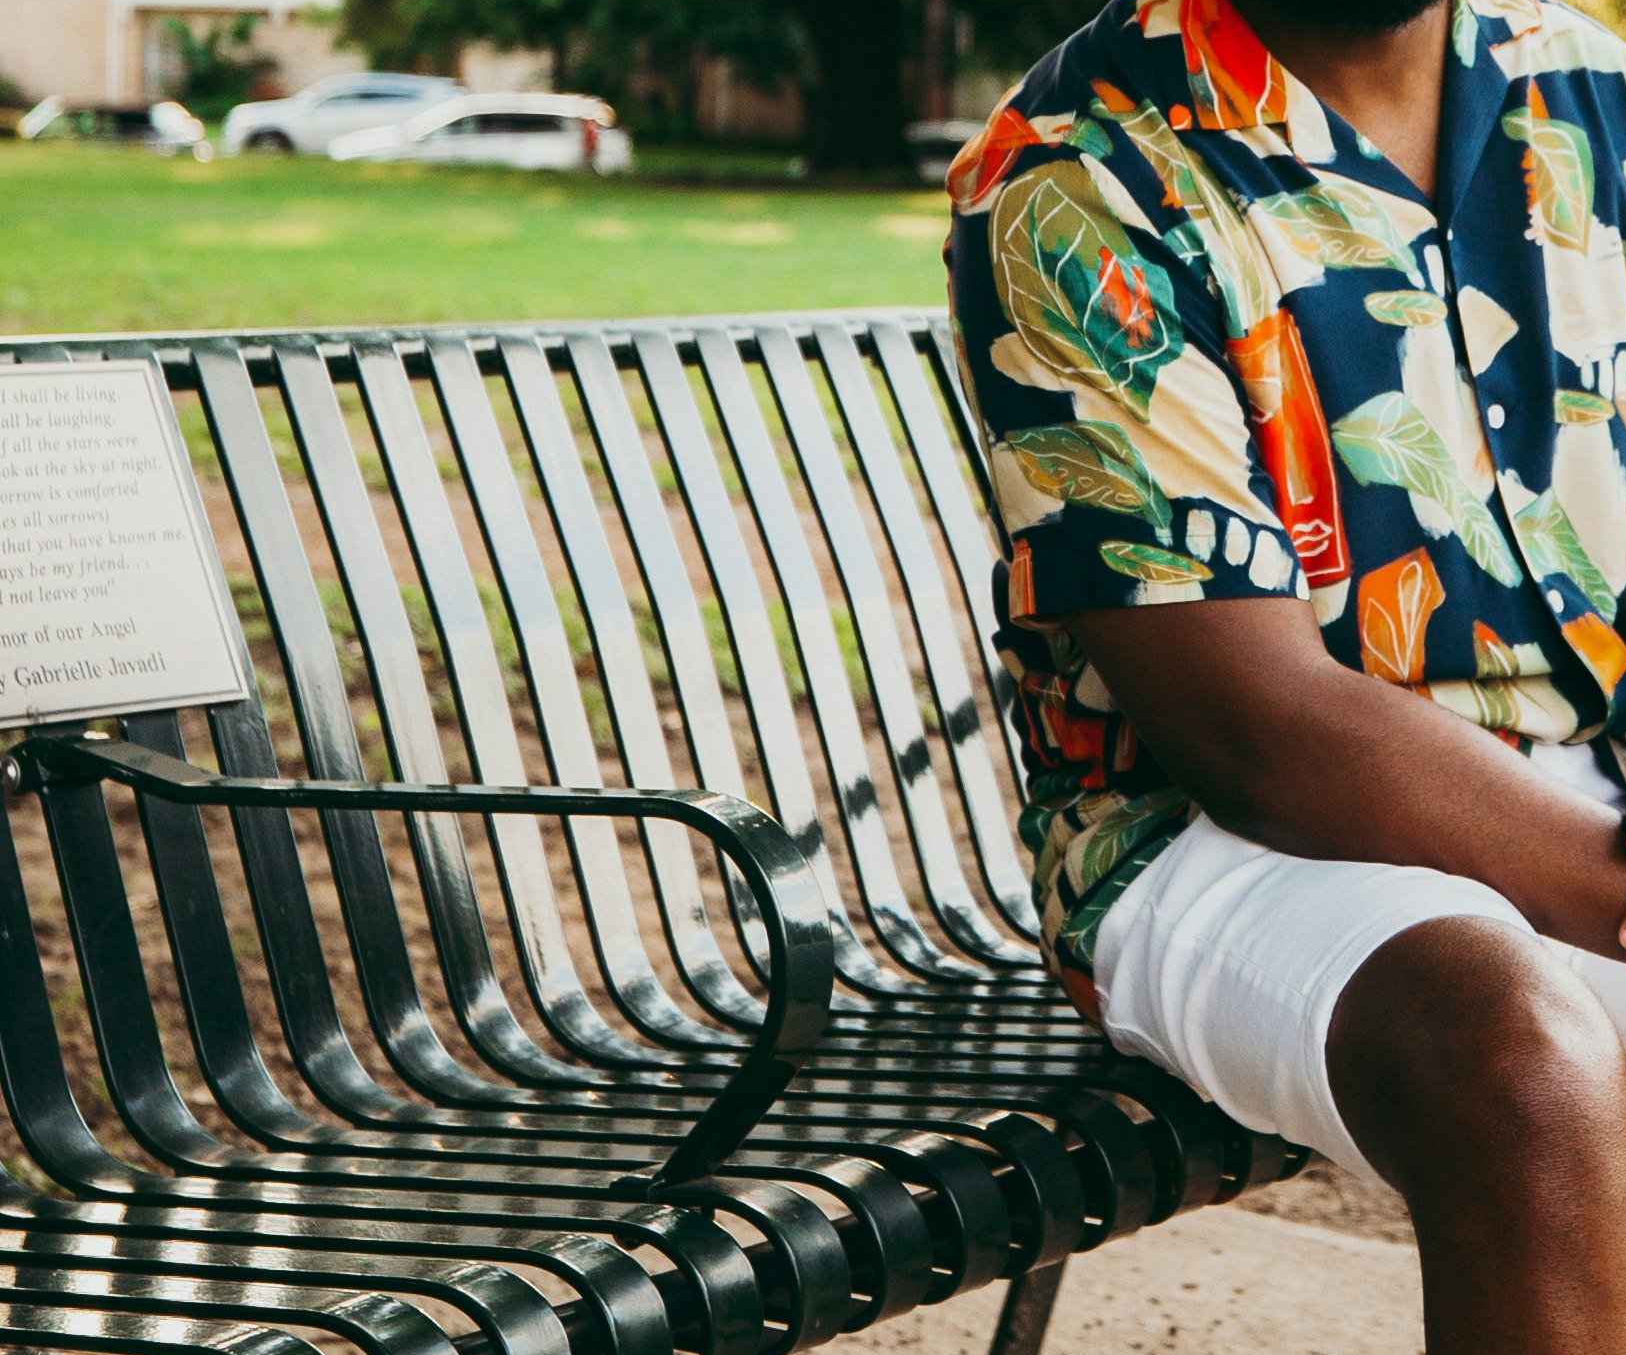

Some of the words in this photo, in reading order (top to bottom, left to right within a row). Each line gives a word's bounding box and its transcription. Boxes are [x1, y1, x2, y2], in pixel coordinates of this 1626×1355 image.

[13, 388, 48, 404] shall
[54, 387, 69, 402] be
[76, 386, 120, 404] living.
[25, 412, 42, 428] be
[48, 409, 116, 429] laughing.
[13, 436, 32, 453] all
[38, 435, 60, 452] the
[66, 435, 101, 450] stars
[105, 435, 138, 448] were
[25, 463, 39, 477] at
[45, 459, 66, 476] the
[73, 458, 96, 479] sky
[102, 458, 117, 473] at
[121, 453, 162, 475] night.
[49, 484, 61, 501] is
[67, 479, 139, 502] comforted
[23, 510, 42, 528] all
[47, 507, 110, 526] sorrows)
[1, 536, 33, 555] that
[36, 538, 64, 556] you
[69, 533, 104, 549] have
[108, 530, 157, 546] known
[162, 528, 188, 541] me.
[29, 561, 46, 578] be
[53, 561, 74, 579] my
[9, 589, 34, 605] not
[38, 585, 77, 602] leave
[35, 625, 51, 644] of
[56, 626, 83, 642] our
[91, 617, 138, 640] Angel
[14, 659, 102, 687] Gabrielle
[108, 651, 166, 677] Javadi
